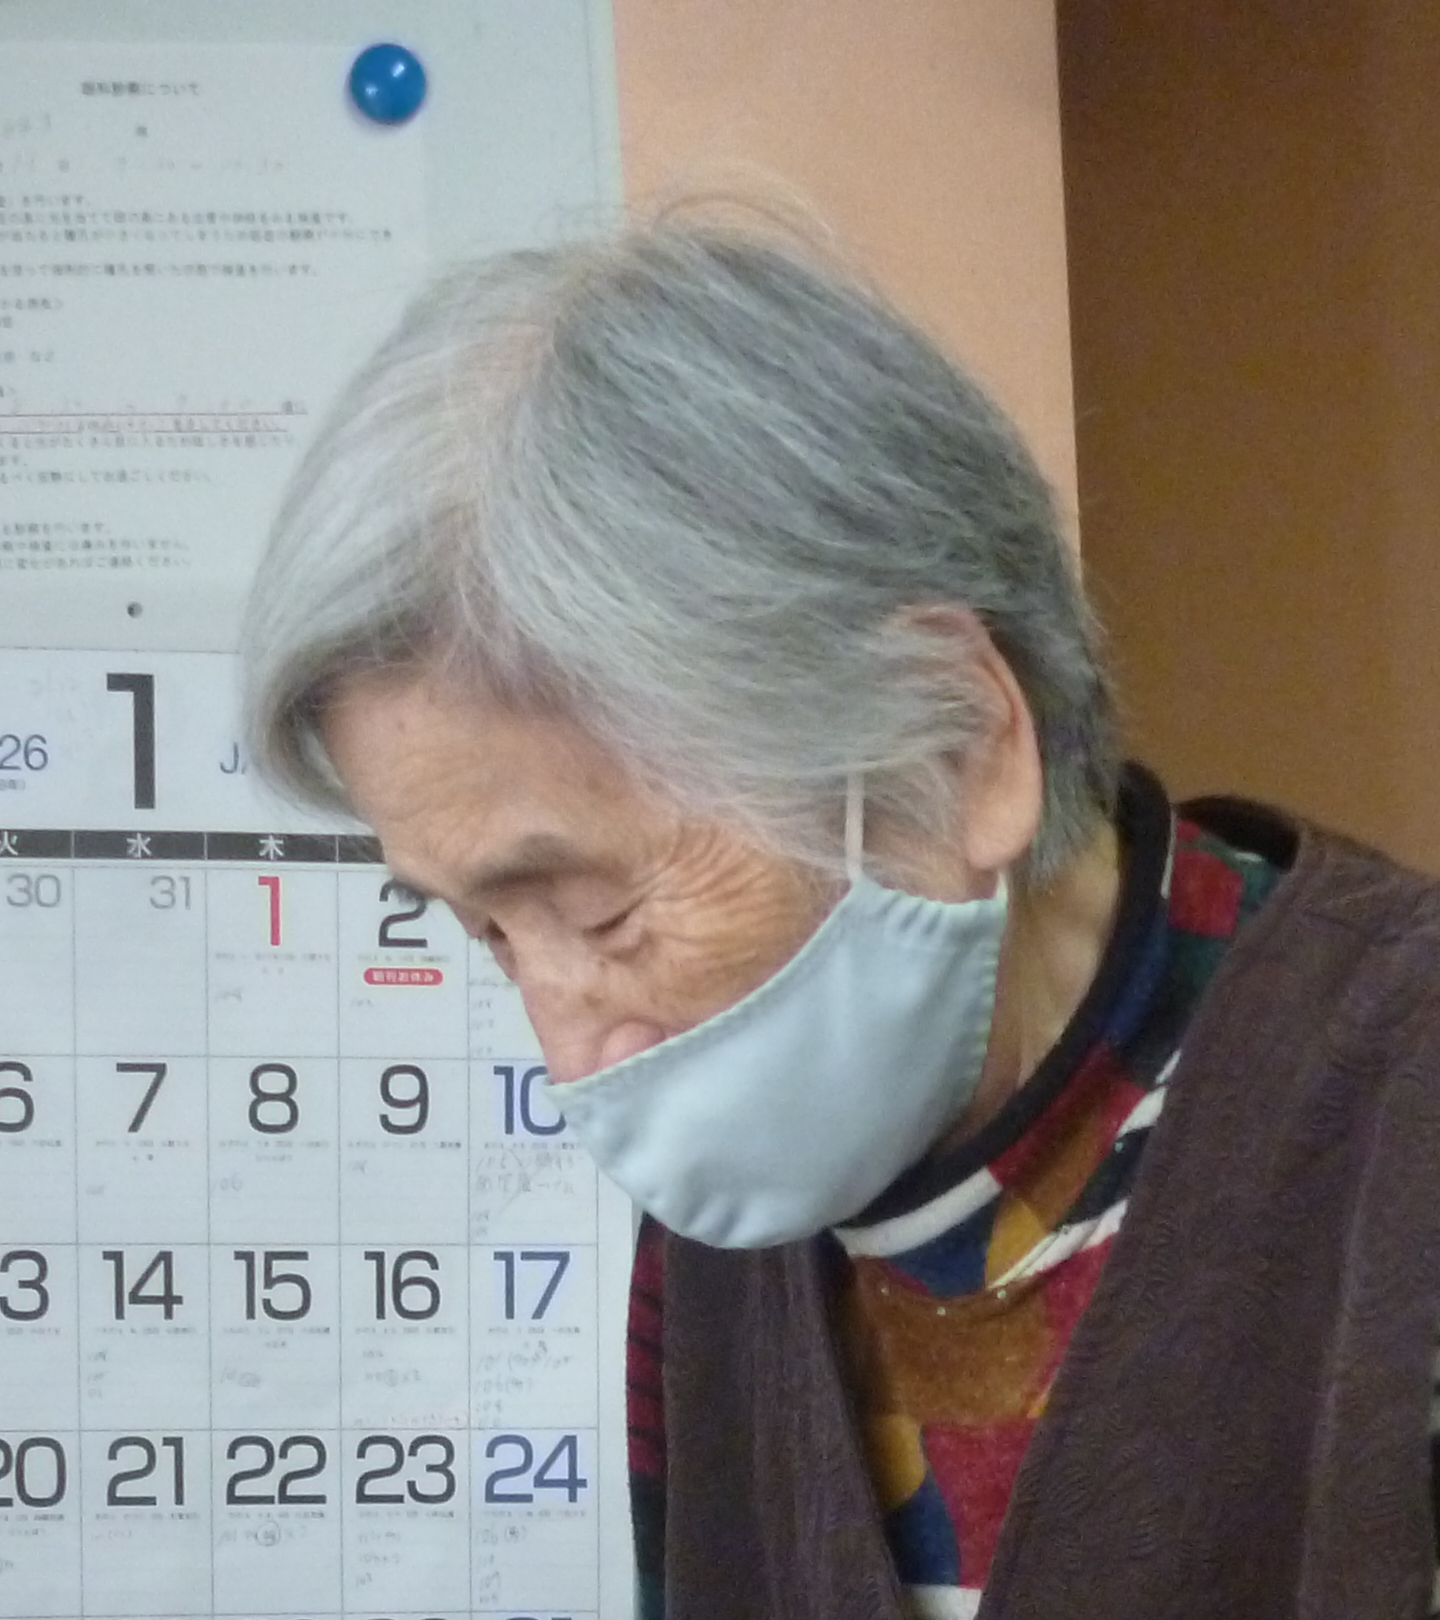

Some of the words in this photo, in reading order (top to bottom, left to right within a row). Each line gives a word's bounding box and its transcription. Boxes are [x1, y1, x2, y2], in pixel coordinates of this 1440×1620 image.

[107, 673, 155, 809] 1
[127, 833, 151, 857] 水
[259, 834, 284, 860] 木
[7, 873, 61, 908] 30
[150, 875, 190, 909] 31
[259, 876, 280, 945] 1
[378, 878, 428, 948] 2
[116, 1063, 166, 1132] 7
[249, 1063, 298, 1134] 8
[380, 1065, 428, 1134] 9
[493, 1065, 567, 1135] 10
[103, 1251, 183, 1320] 14
[234, 1251, 311, 1320] 15
[365, 1251, 440, 1320] 16
[494, 1251, 569, 1319] 17
[107, 1437, 184, 1506] 21
[227, 1436, 326, 1505] 22
[356, 1435, 455, 1504] 23
[485, 1435, 587, 1503] 24
